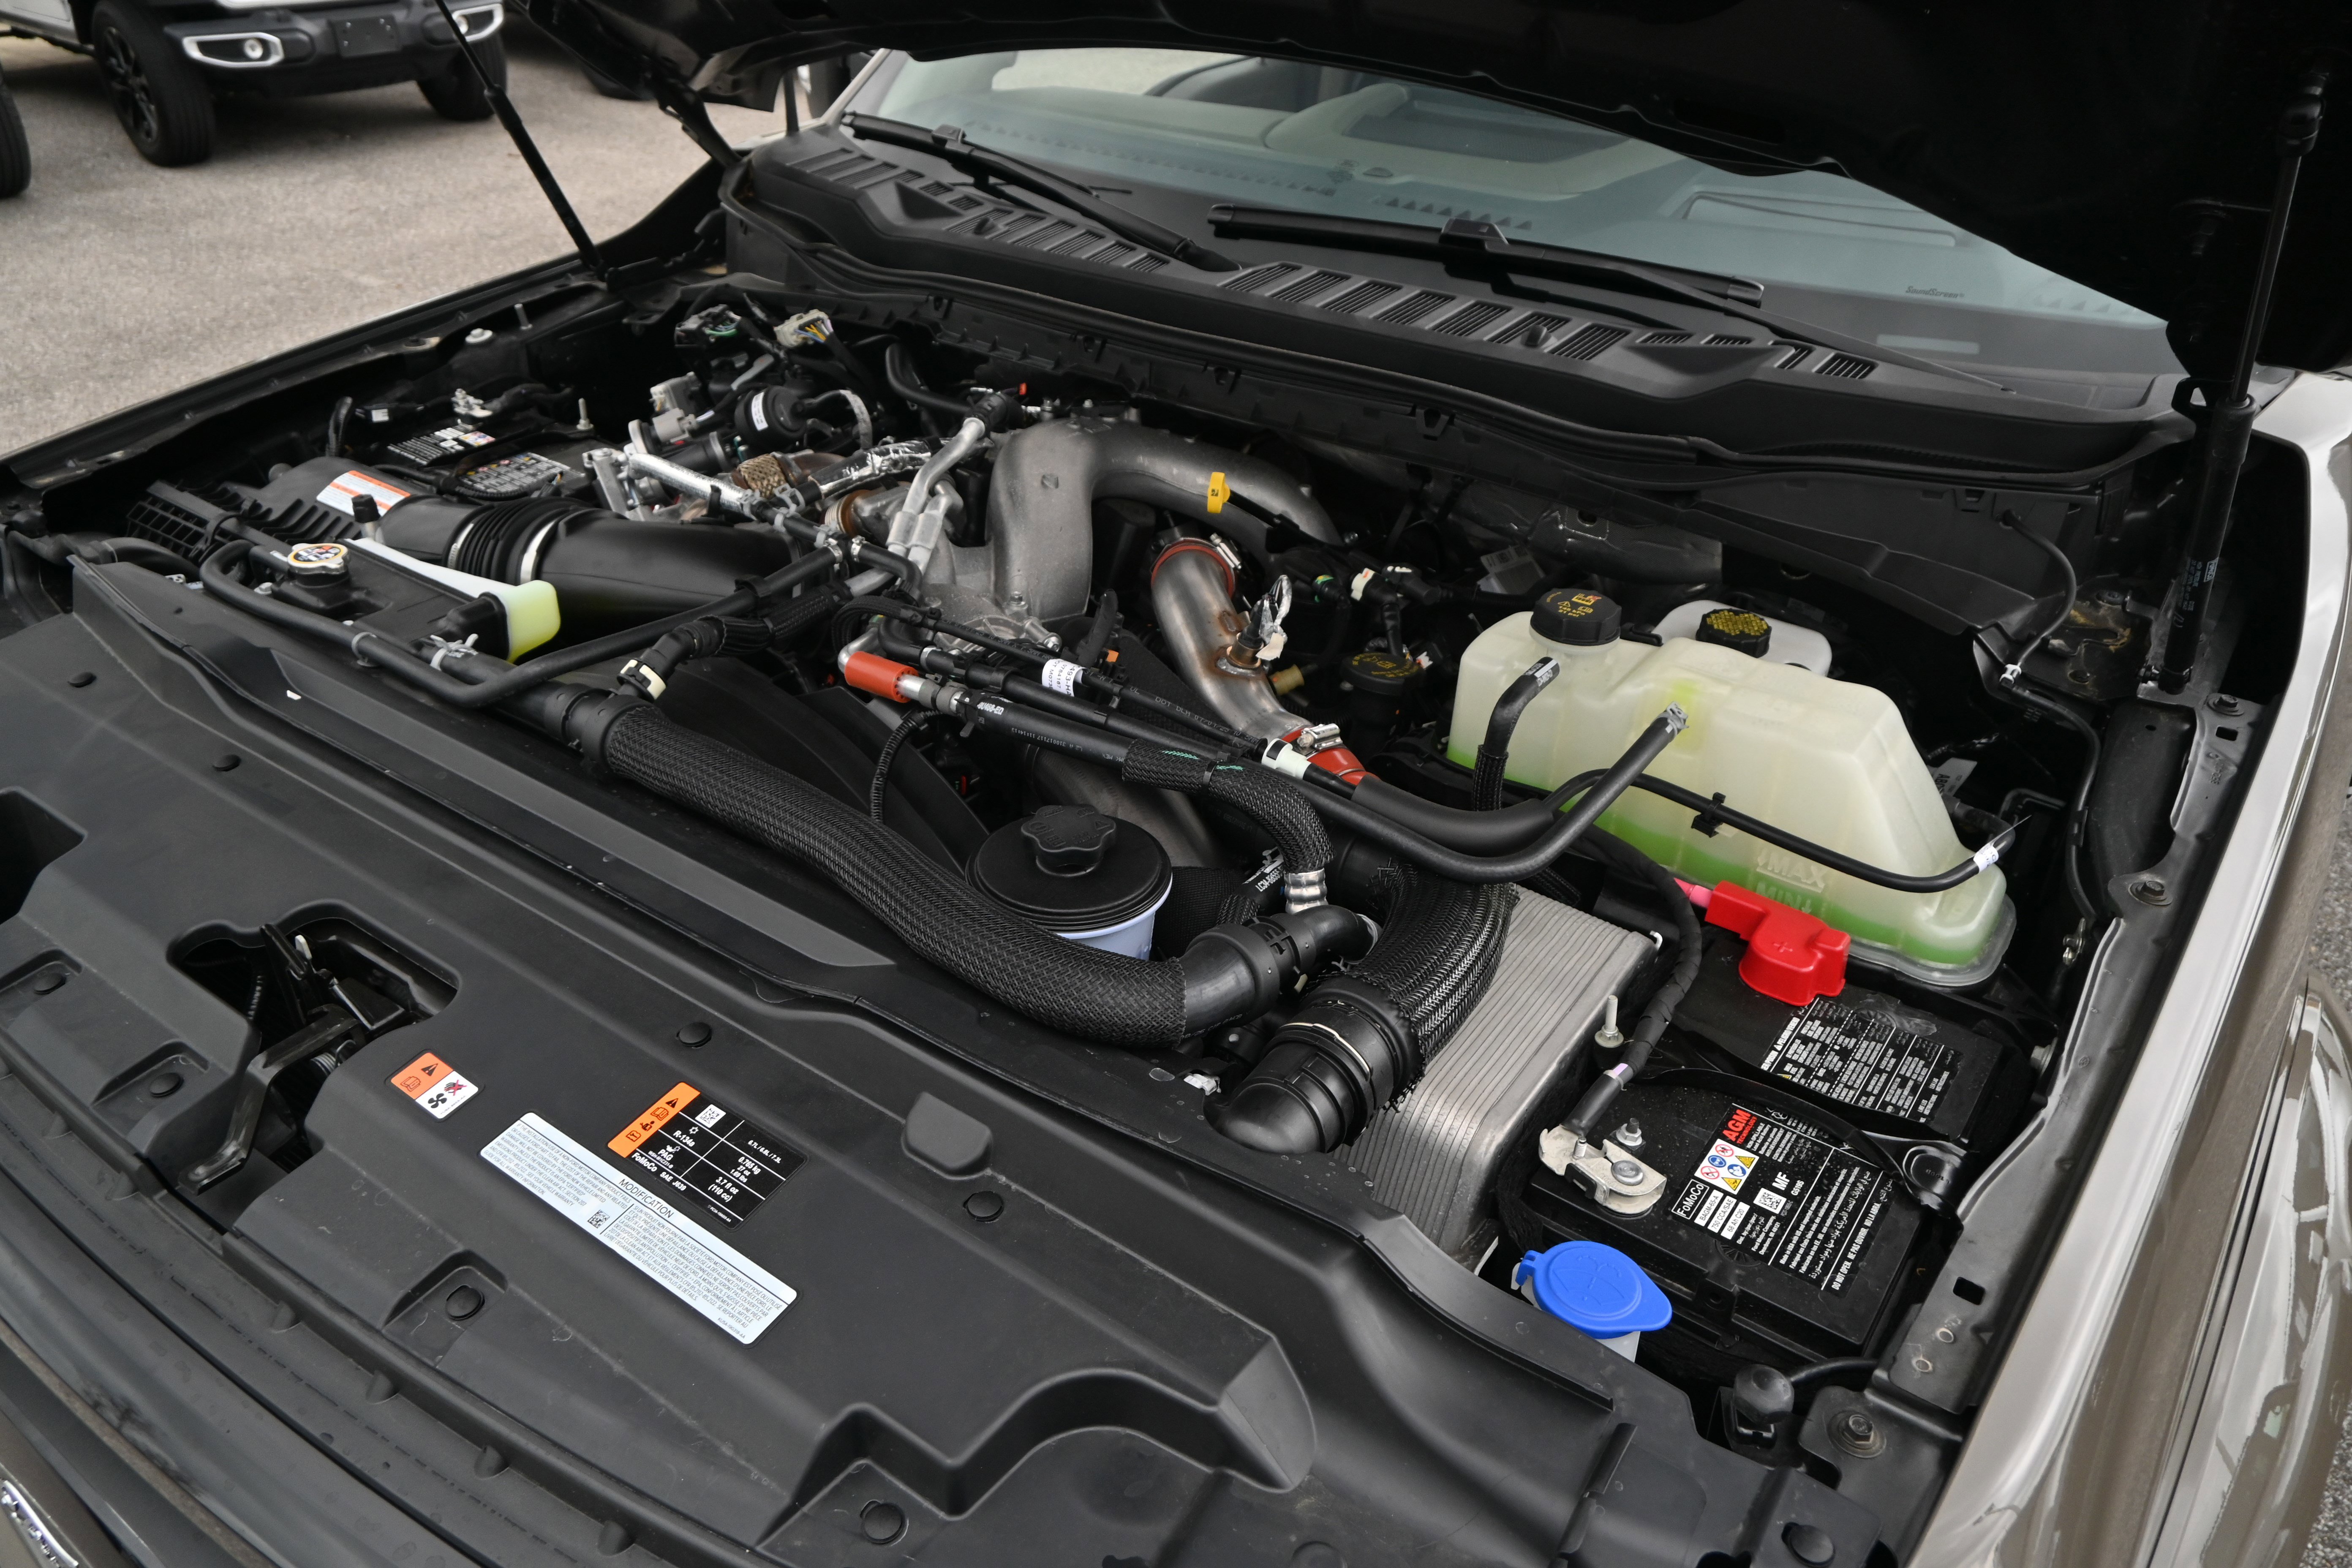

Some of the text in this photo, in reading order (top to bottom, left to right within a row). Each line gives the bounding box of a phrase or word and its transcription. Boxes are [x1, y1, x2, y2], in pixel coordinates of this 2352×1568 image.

[1767, 852, 1827, 888] MAX
[1723, 1109, 1751, 1141] AGM
[1737, 1116, 1757, 1144] TECHNOLOGY
[673, 1130, 695, 1147] R-134a
[658, 1149, 673, 1161] PAG
[632, 1152, 687, 1191] FoMoCo SAE J639
[738, 1157, 761, 1175] 0.765 kg
[716, 1176, 728, 1185] 3.7
[730, 1169, 748, 1183] 1.69 lbs
[1772, 1171, 1790, 1190] MF
[708, 1184, 733, 1203] (110 cc)
[1791, 1180, 1805, 1195] G519S
[618, 1179, 674, 1218] MODIFICATION
[1677, 1184, 1704, 1217] FoMoCo
[1699, 1195, 1719, 1221] BAGM-65-A
[1711, 1199, 1734, 1229] 750 CCA/SAE
[1735, 1209, 1745, 1219] C20
[1864, 1219, 1873, 1227] NO
[1751, 1241, 1760, 1252] Ford
[1850, 1243, 1860, 1253] PAS
[1847, 1252, 1856, 1260] NE
[1832, 1282, 1841, 1290] DO
[1835, 1272, 1846, 1283] NOT
